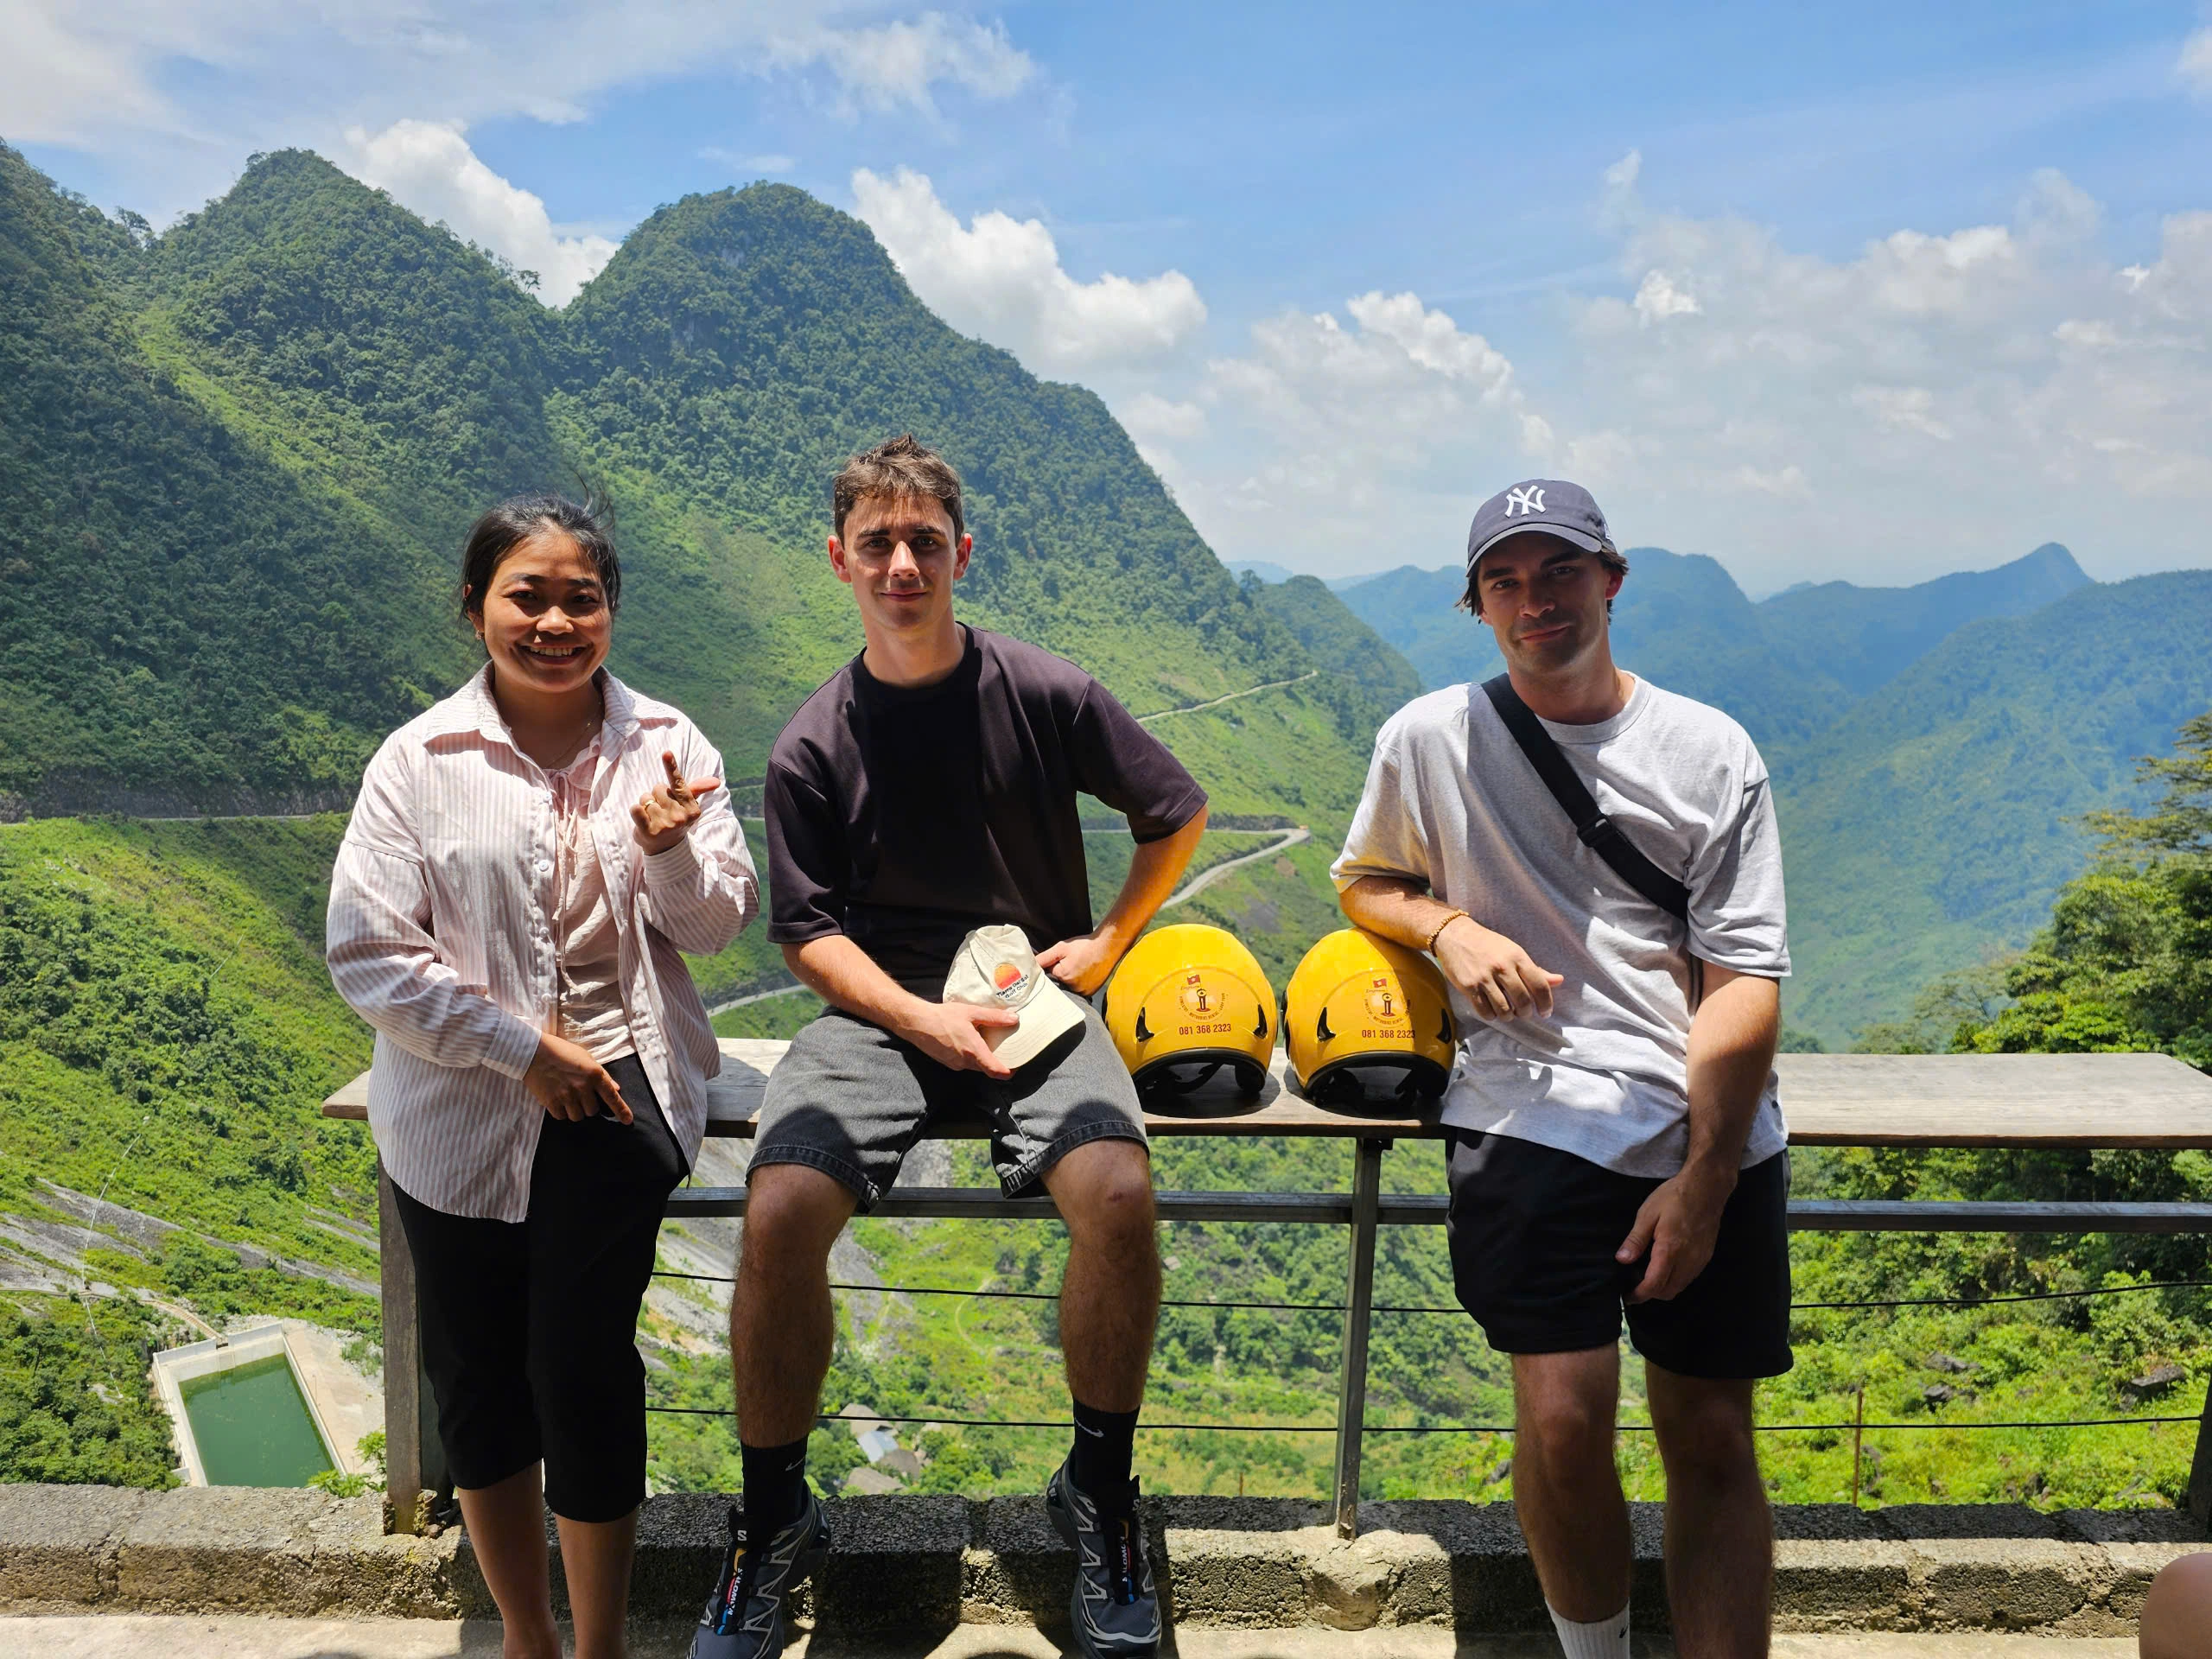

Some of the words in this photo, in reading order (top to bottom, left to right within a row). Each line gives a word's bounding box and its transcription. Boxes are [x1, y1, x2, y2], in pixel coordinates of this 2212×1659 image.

[1504, 485, 1547, 518] NY
[1005, 988, 1017, 999] Golf
[1179, 1026, 1193, 1035] 081
[1196, 1025, 1211, 1034] 368
[1213, 1023, 1231, 1033] 2323
[1362, 1029, 1376, 1039] 081
[1379, 1029, 1395, 1039] 368
[1396, 1029, 1416, 1039] 2323
